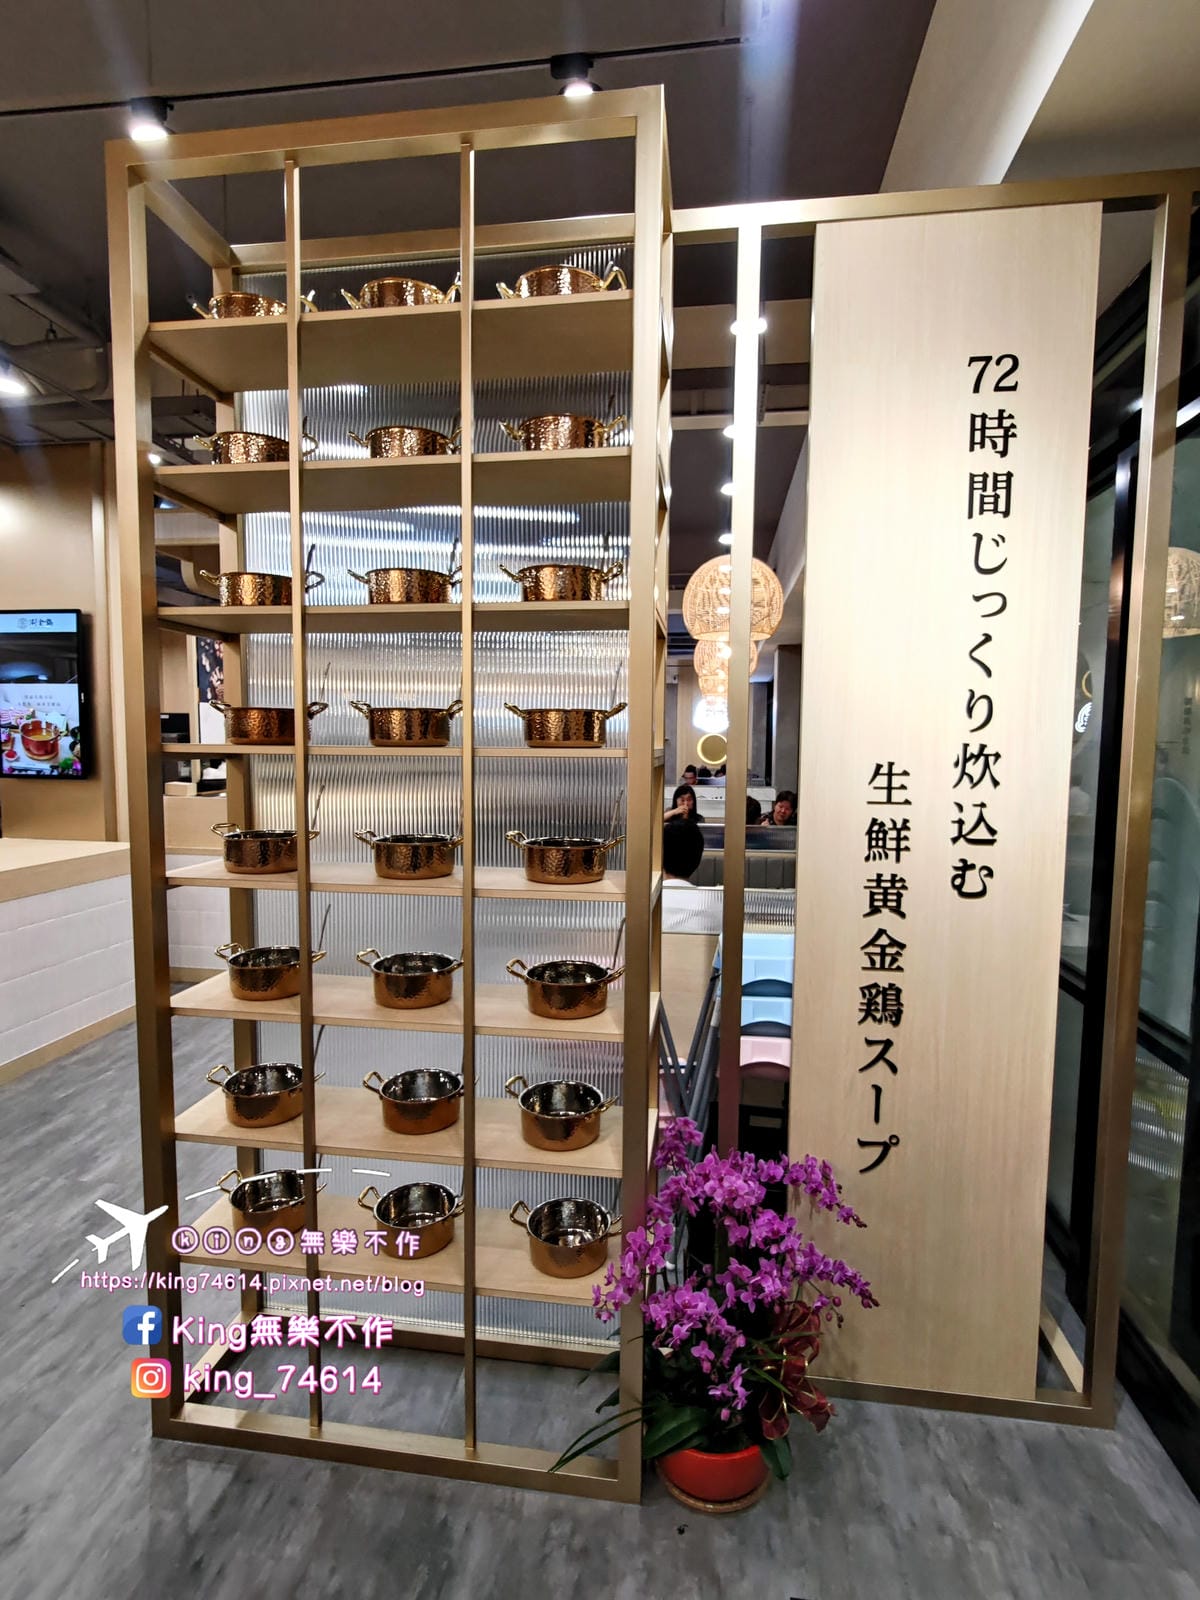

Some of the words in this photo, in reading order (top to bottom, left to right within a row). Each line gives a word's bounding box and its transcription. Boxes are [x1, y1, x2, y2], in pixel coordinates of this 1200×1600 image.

[950, 353, 1020, 900] 72時間じっくり炊込む
[856, 761, 912, 1174] 生鮮黄金鶏スープ
